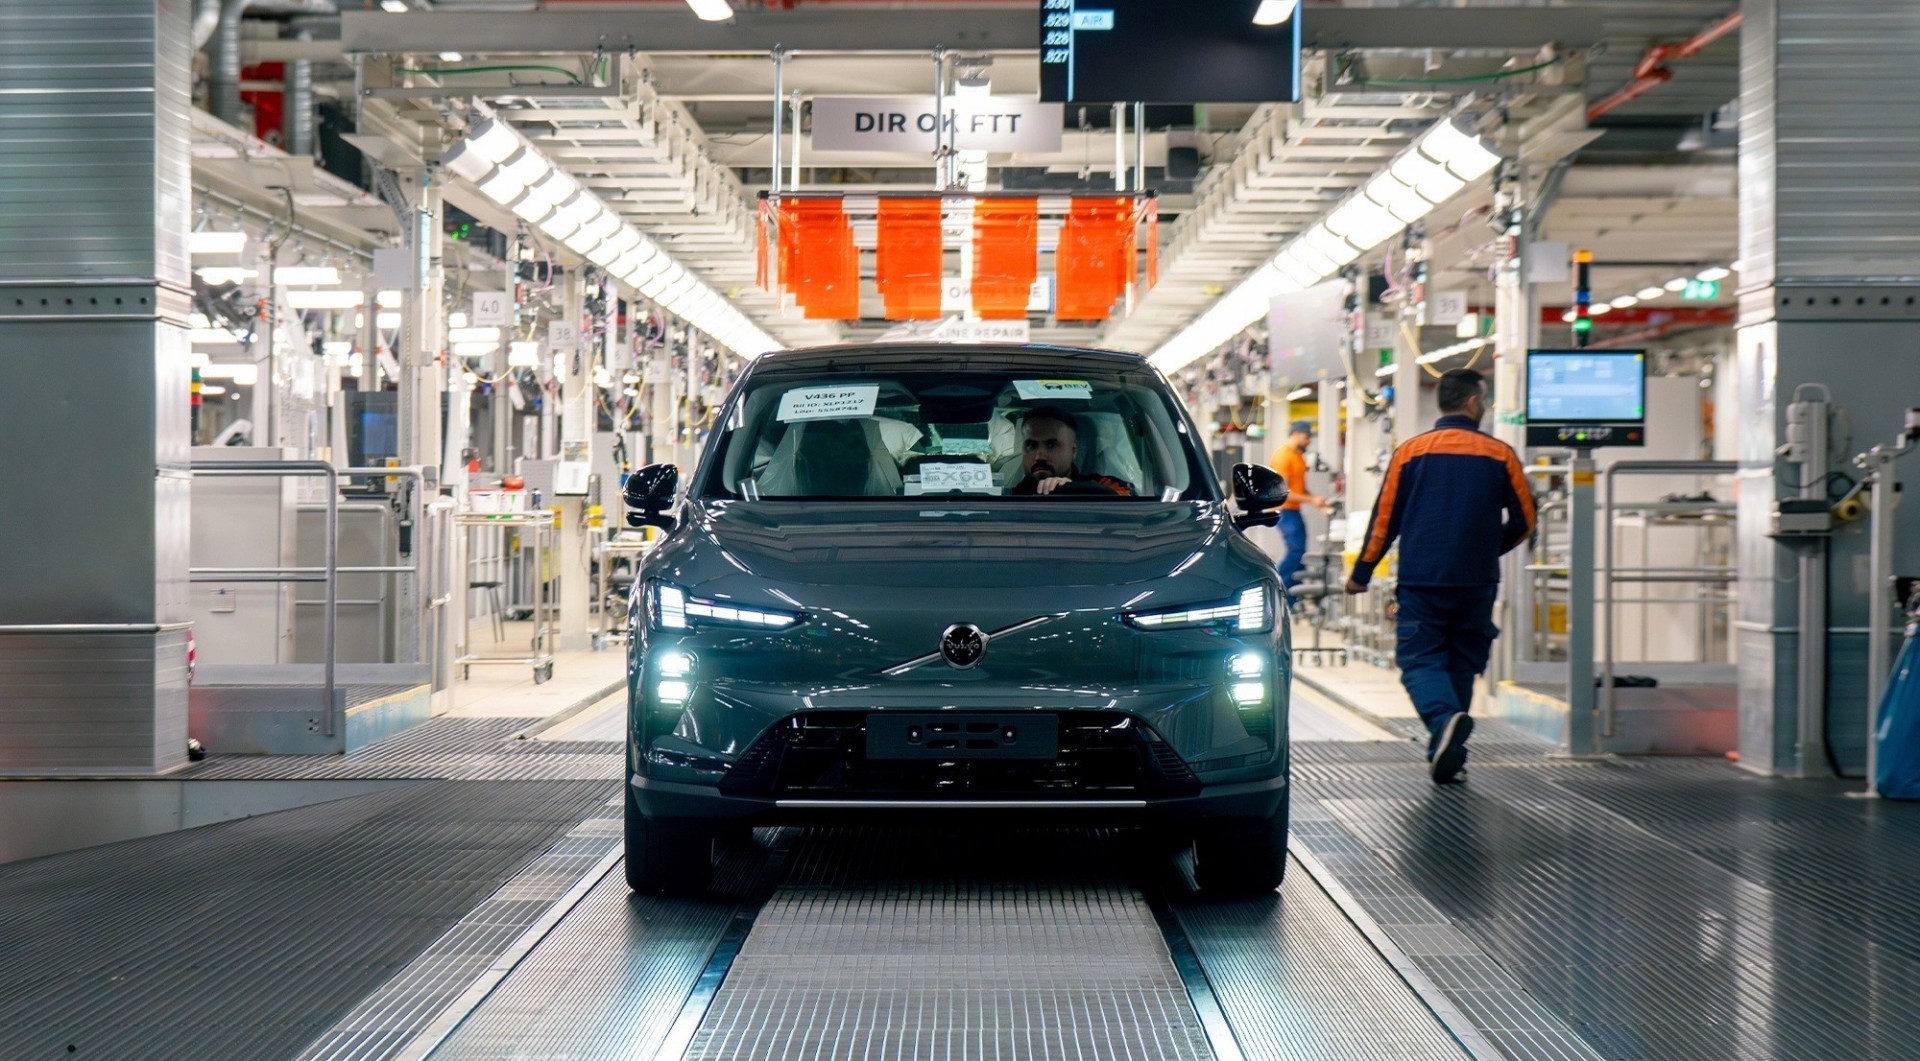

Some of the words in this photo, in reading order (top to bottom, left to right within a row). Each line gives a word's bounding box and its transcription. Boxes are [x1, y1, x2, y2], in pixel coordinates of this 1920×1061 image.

[855, 112, 907, 133] DIR
[916, 112, 959, 133] OK
[970, 113, 1022, 133] FTT
[480, 299, 499, 314] 40
[556, 327, 571, 341] 38
